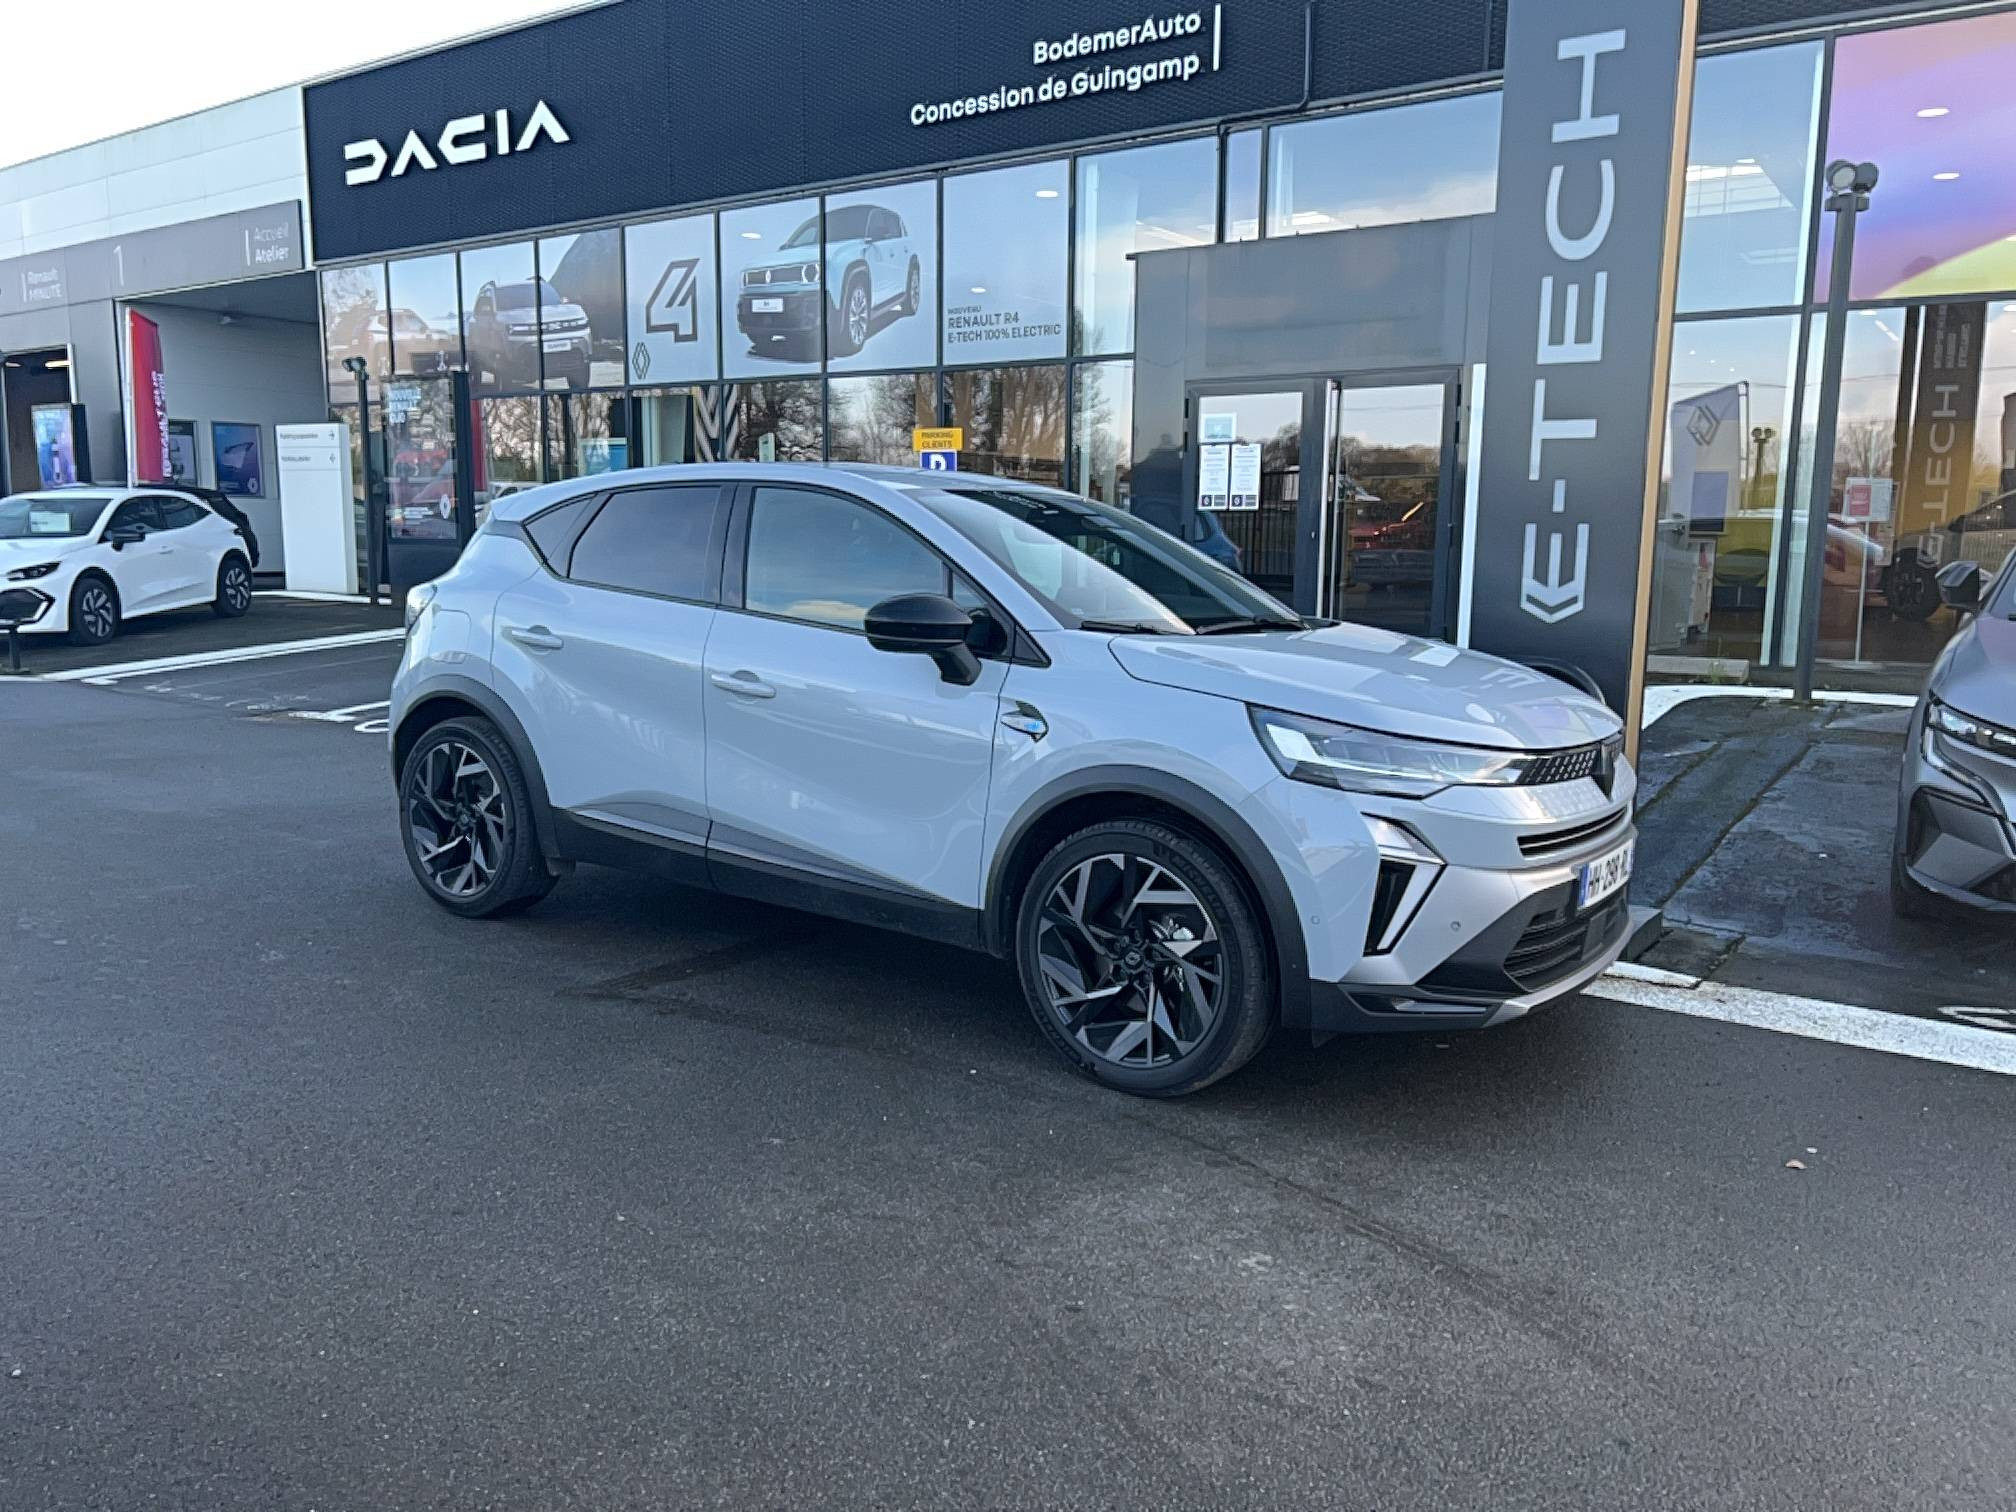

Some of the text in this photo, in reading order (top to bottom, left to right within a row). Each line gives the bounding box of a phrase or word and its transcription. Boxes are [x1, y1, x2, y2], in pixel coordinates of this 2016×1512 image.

[1033, 11, 1202, 64] BodemerAuto
[910, 53, 1201, 126] Concession de Guingamp
[344, 98, 571, 186] DACIA
[255, 245, 289, 264] Atelier
[947, 305, 982, 315] NOUVEAU
[947, 311, 1020, 329] RENAULT R4
[1520, 28, 1627, 624] E-TECH
[947, 324, 1062, 344] E-TECH 100% ELECTRIC
[920, 431, 954, 439] PARKING
[921, 440, 953, 448] CLIENTS
